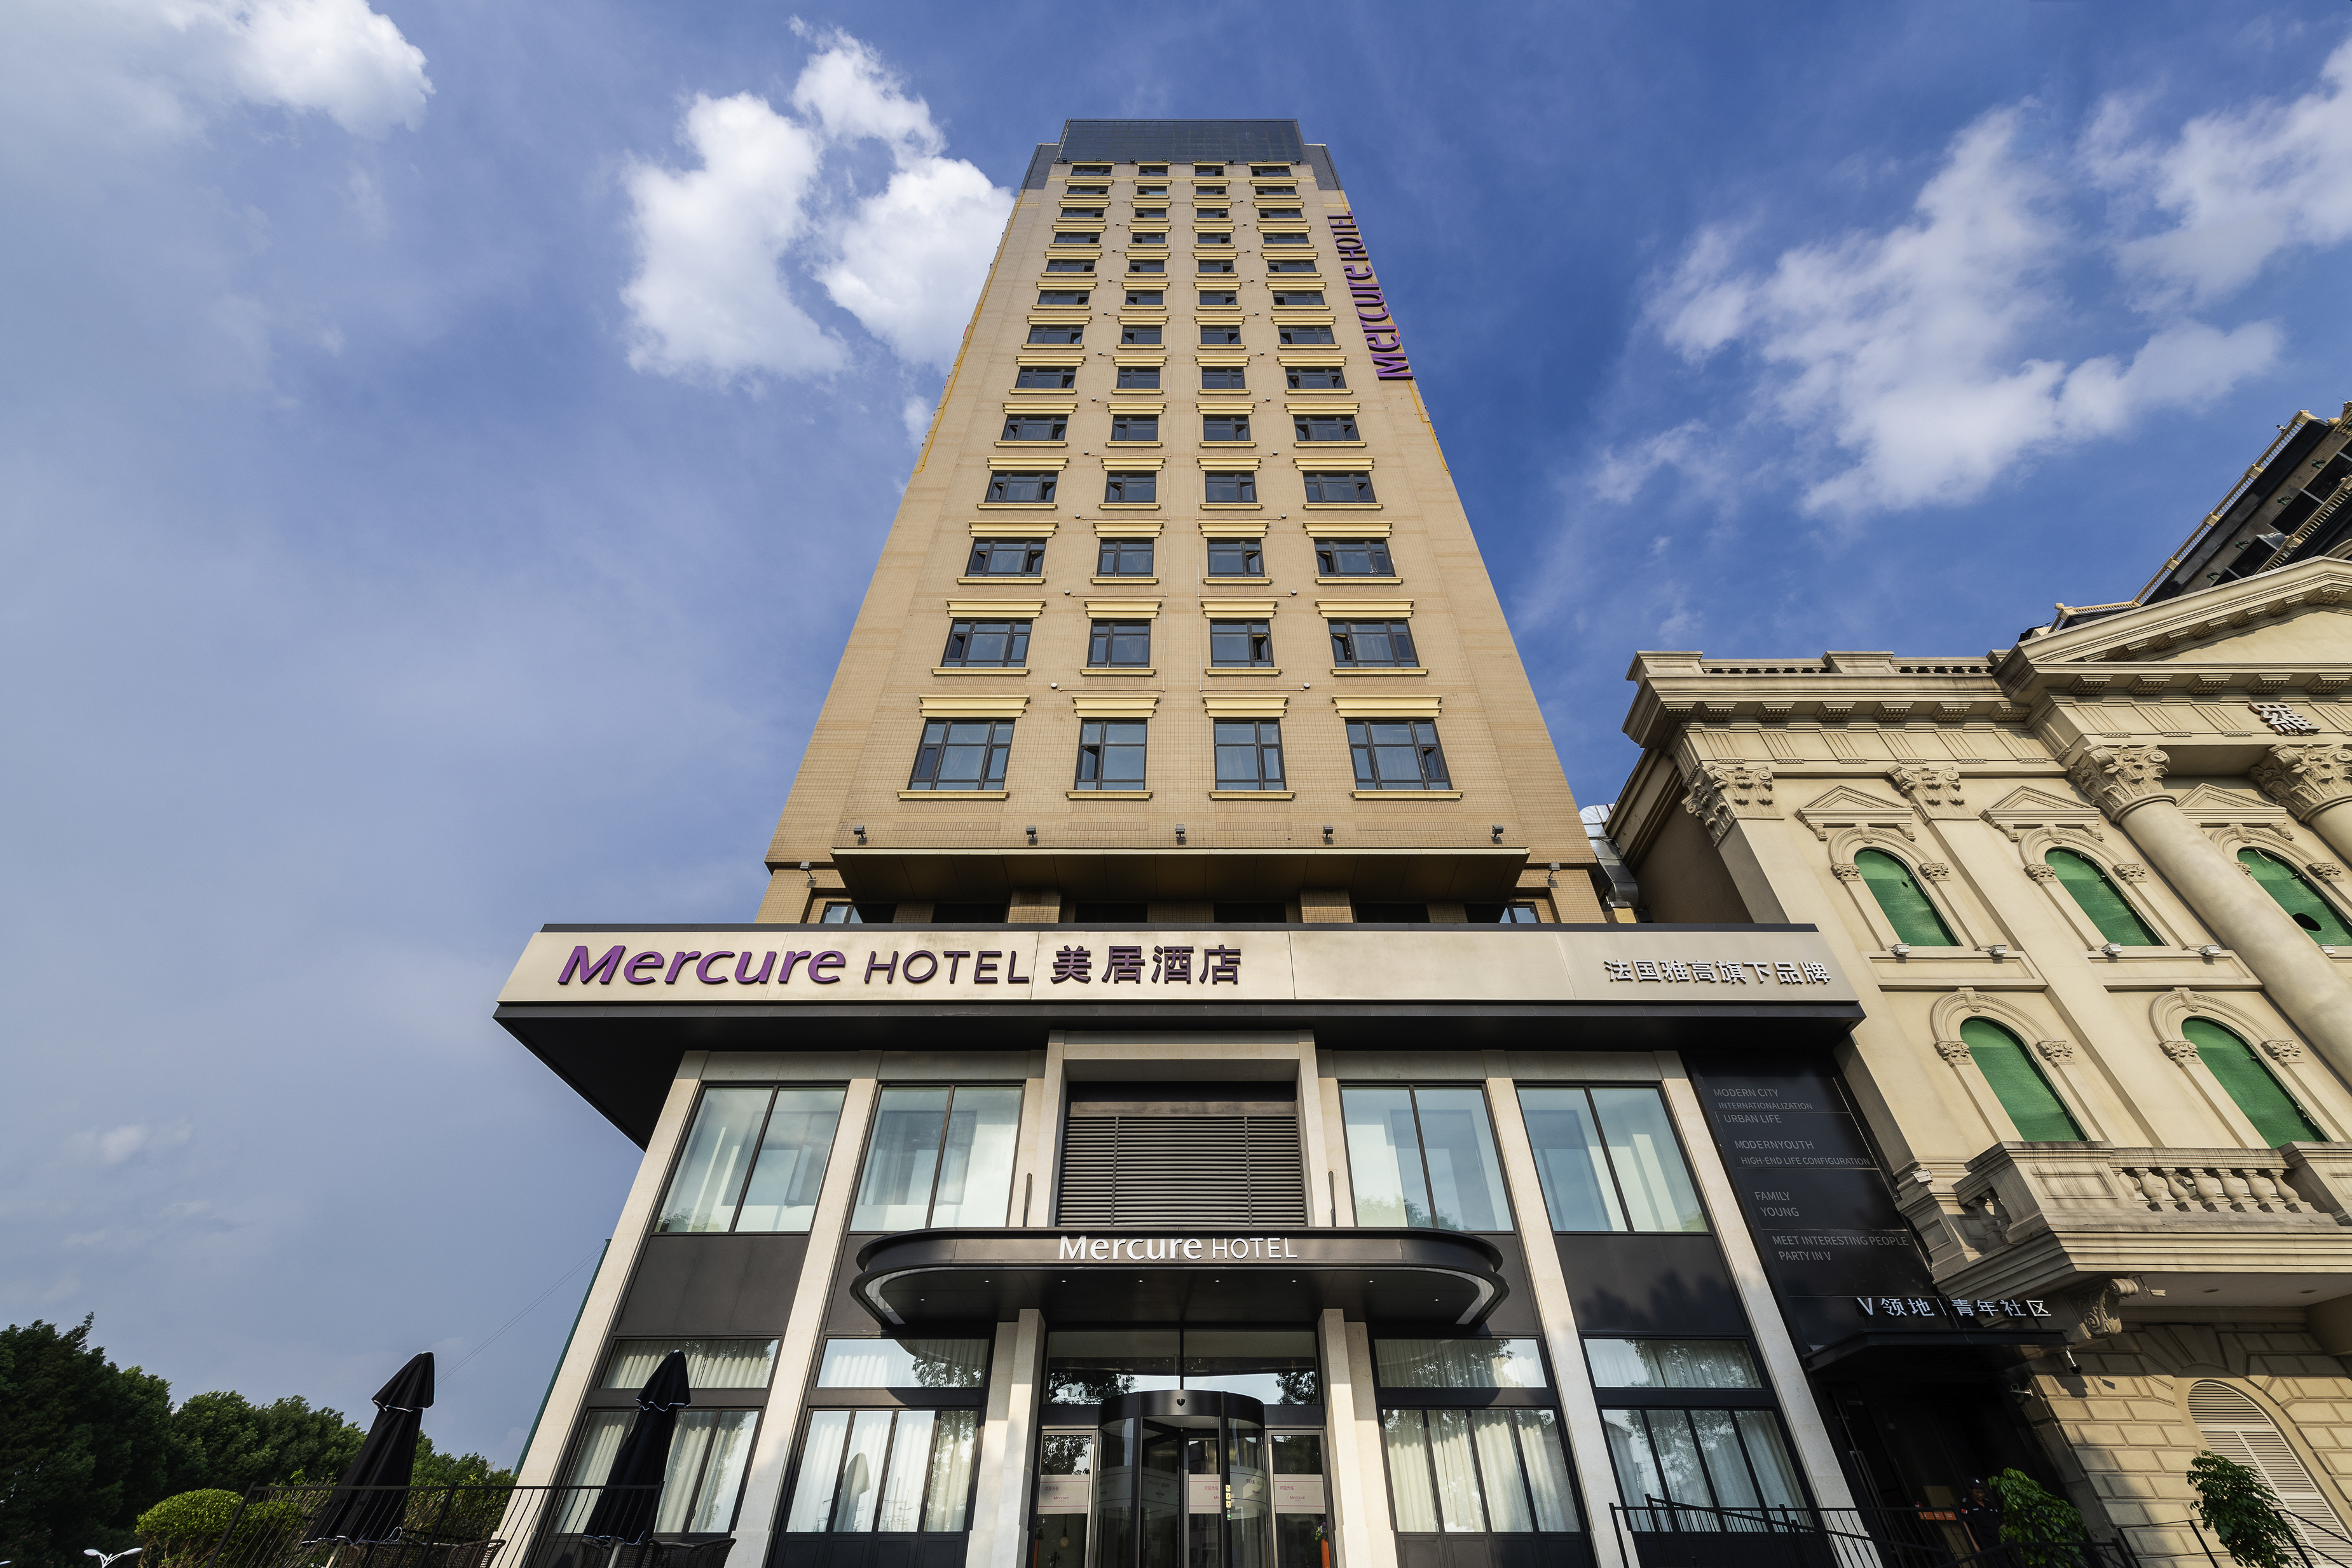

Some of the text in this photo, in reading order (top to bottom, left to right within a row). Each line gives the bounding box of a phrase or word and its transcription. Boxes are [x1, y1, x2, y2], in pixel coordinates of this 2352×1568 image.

[1327, 210, 1414, 381] Mercure HOTEL
[557, 944, 1241, 985] Mercure HOTEL 美居酒店
[1603, 958, 1831, 985] 法国雅高旗下品牌
[1713, 1088, 1779, 1097] MODERN CITY
[1723, 1114, 1782, 1123] URBAN LIFE
[1783, 1157, 1802, 1165] LIFE
[1802, 1157, 1871, 1166] CONFIGURATION
[1754, 1191, 1790, 1201] FAMILY
[1760, 1207, 1800, 1217] YOUNG
[1772, 1236, 1909, 1246] MEET INTERESTING PEOPLE
[1058, 1235, 1298, 1260] Mercure HOTEL
[1778, 1251, 1831, 1260] PARTY IN V
[1952, 1299, 2051, 1317] 青年社区
